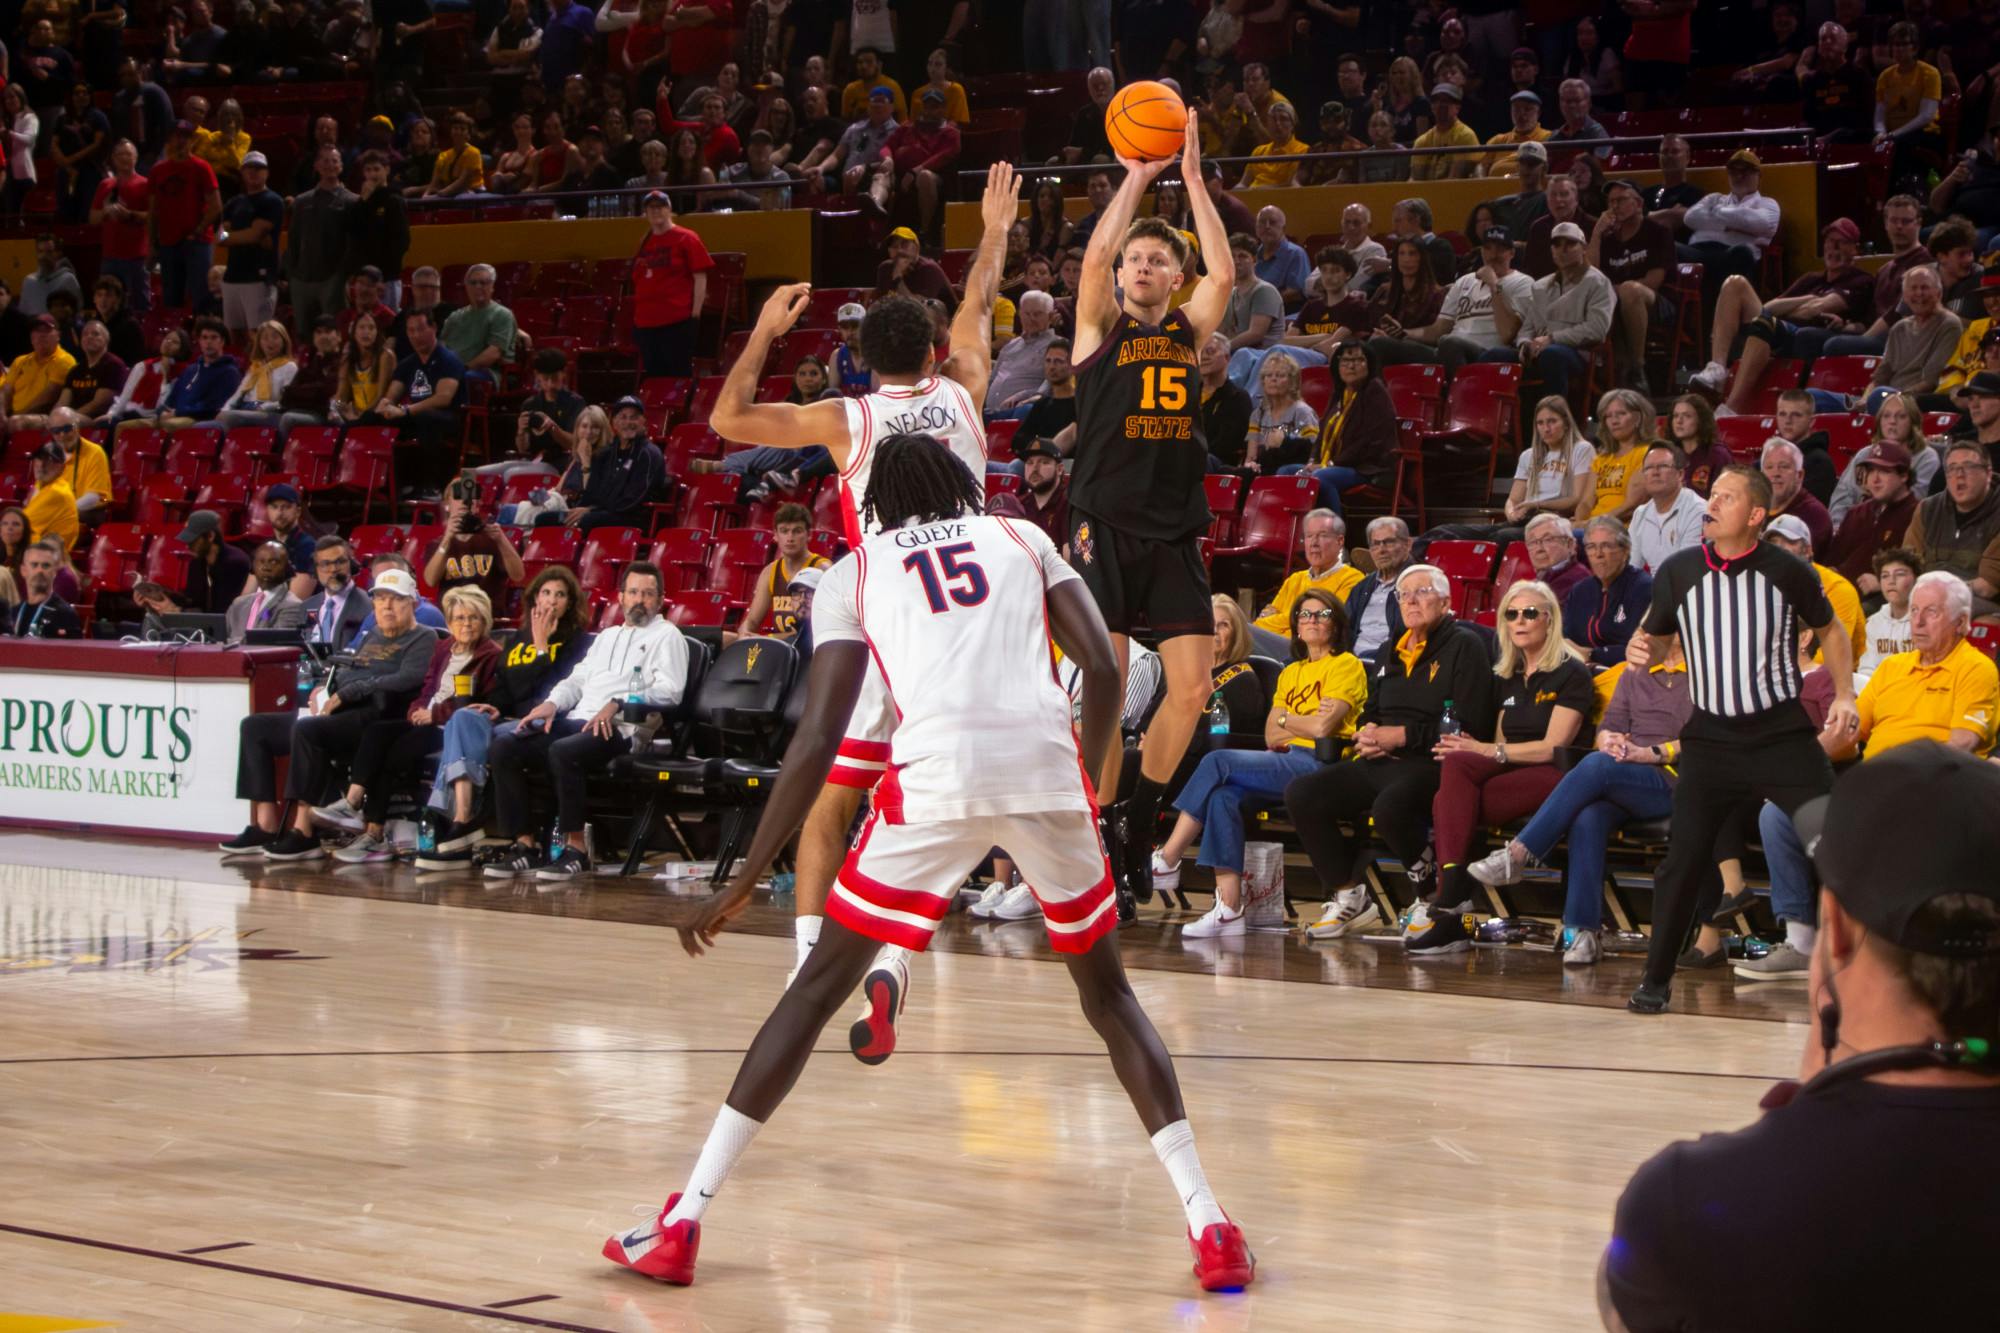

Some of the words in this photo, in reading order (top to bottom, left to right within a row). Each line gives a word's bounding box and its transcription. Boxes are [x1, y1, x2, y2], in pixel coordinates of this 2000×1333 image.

[1116, 336, 1198, 367] ARIZONA
[1141, 367, 1188, 410] 15
[885, 407, 957, 435] NELSON
[1125, 415, 1192, 440] STATE
[895, 525, 968, 549] GUEYE
[446, 555, 493, 579] ASU
[902, 541, 990, 614] 15
[1, 698, 193, 763] PROUTS
[0, 763, 82, 793] ARMERS
[88, 768, 182, 800] MARKET
